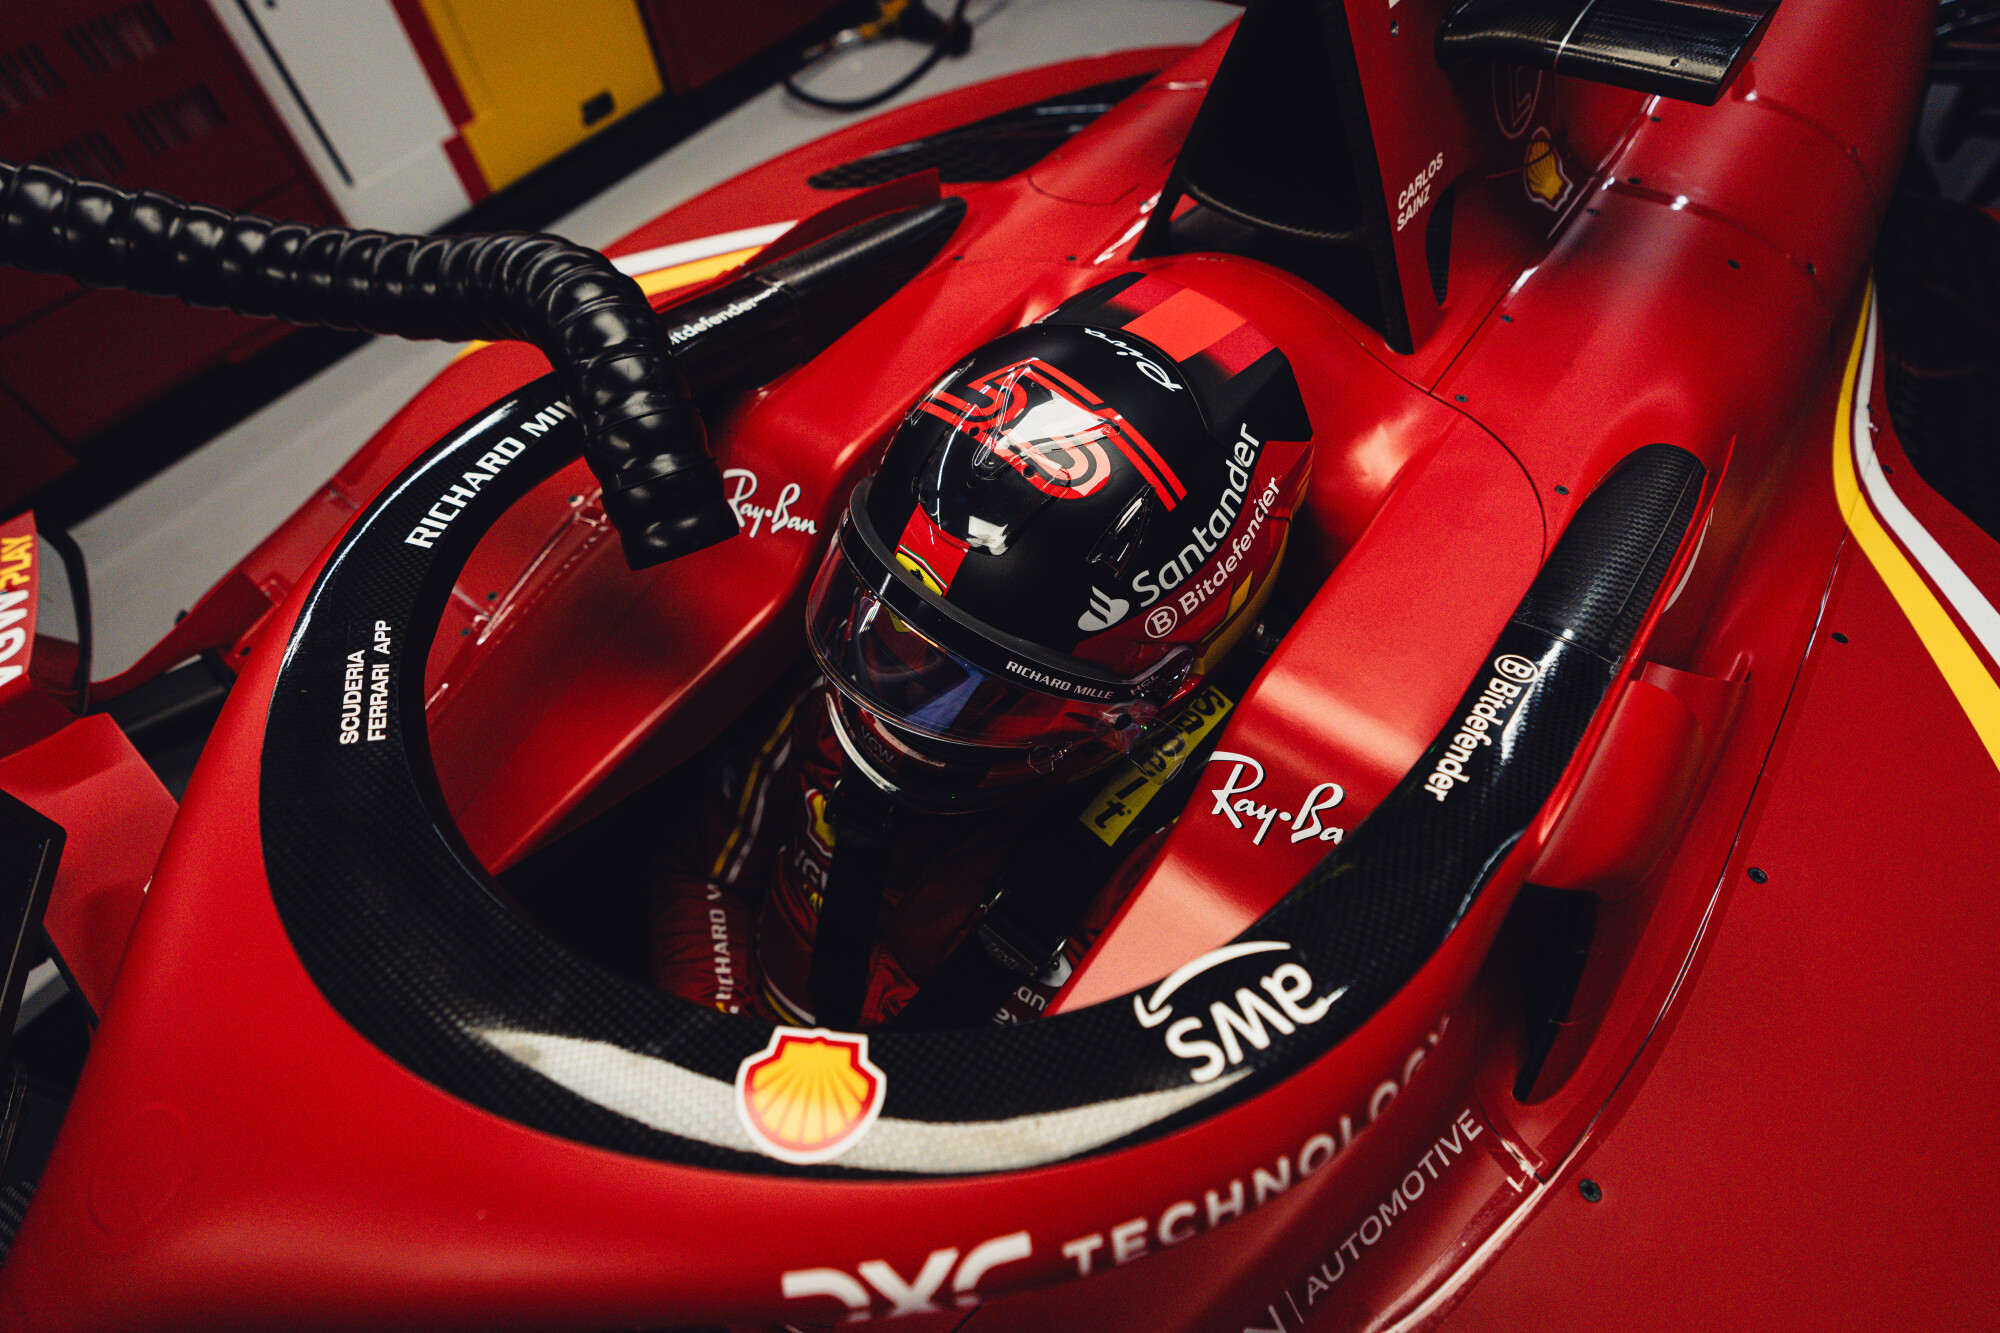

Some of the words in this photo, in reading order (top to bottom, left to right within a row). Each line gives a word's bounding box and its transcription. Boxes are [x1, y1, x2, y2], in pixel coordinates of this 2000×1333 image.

[1397, 183, 1431, 231] SAINZ
[1398, 151, 1443, 210] CARLOS
[404, 436, 527, 549] RICHARD
[1132, 423, 1260, 607] Santander
[373, 620, 392, 654] APP
[1005, 660, 1071, 691] RICHARD
[1074, 685, 1114, 699] MILLE
[339, 649, 365, 745] SCUDERIA
[367, 663, 390, 741] FERRARI
[1424, 677, 1522, 802] Bitdefender
[1165, 963, 1331, 1083] aws
[1308, 1108, 1484, 1306] AUTOMOTIVE
